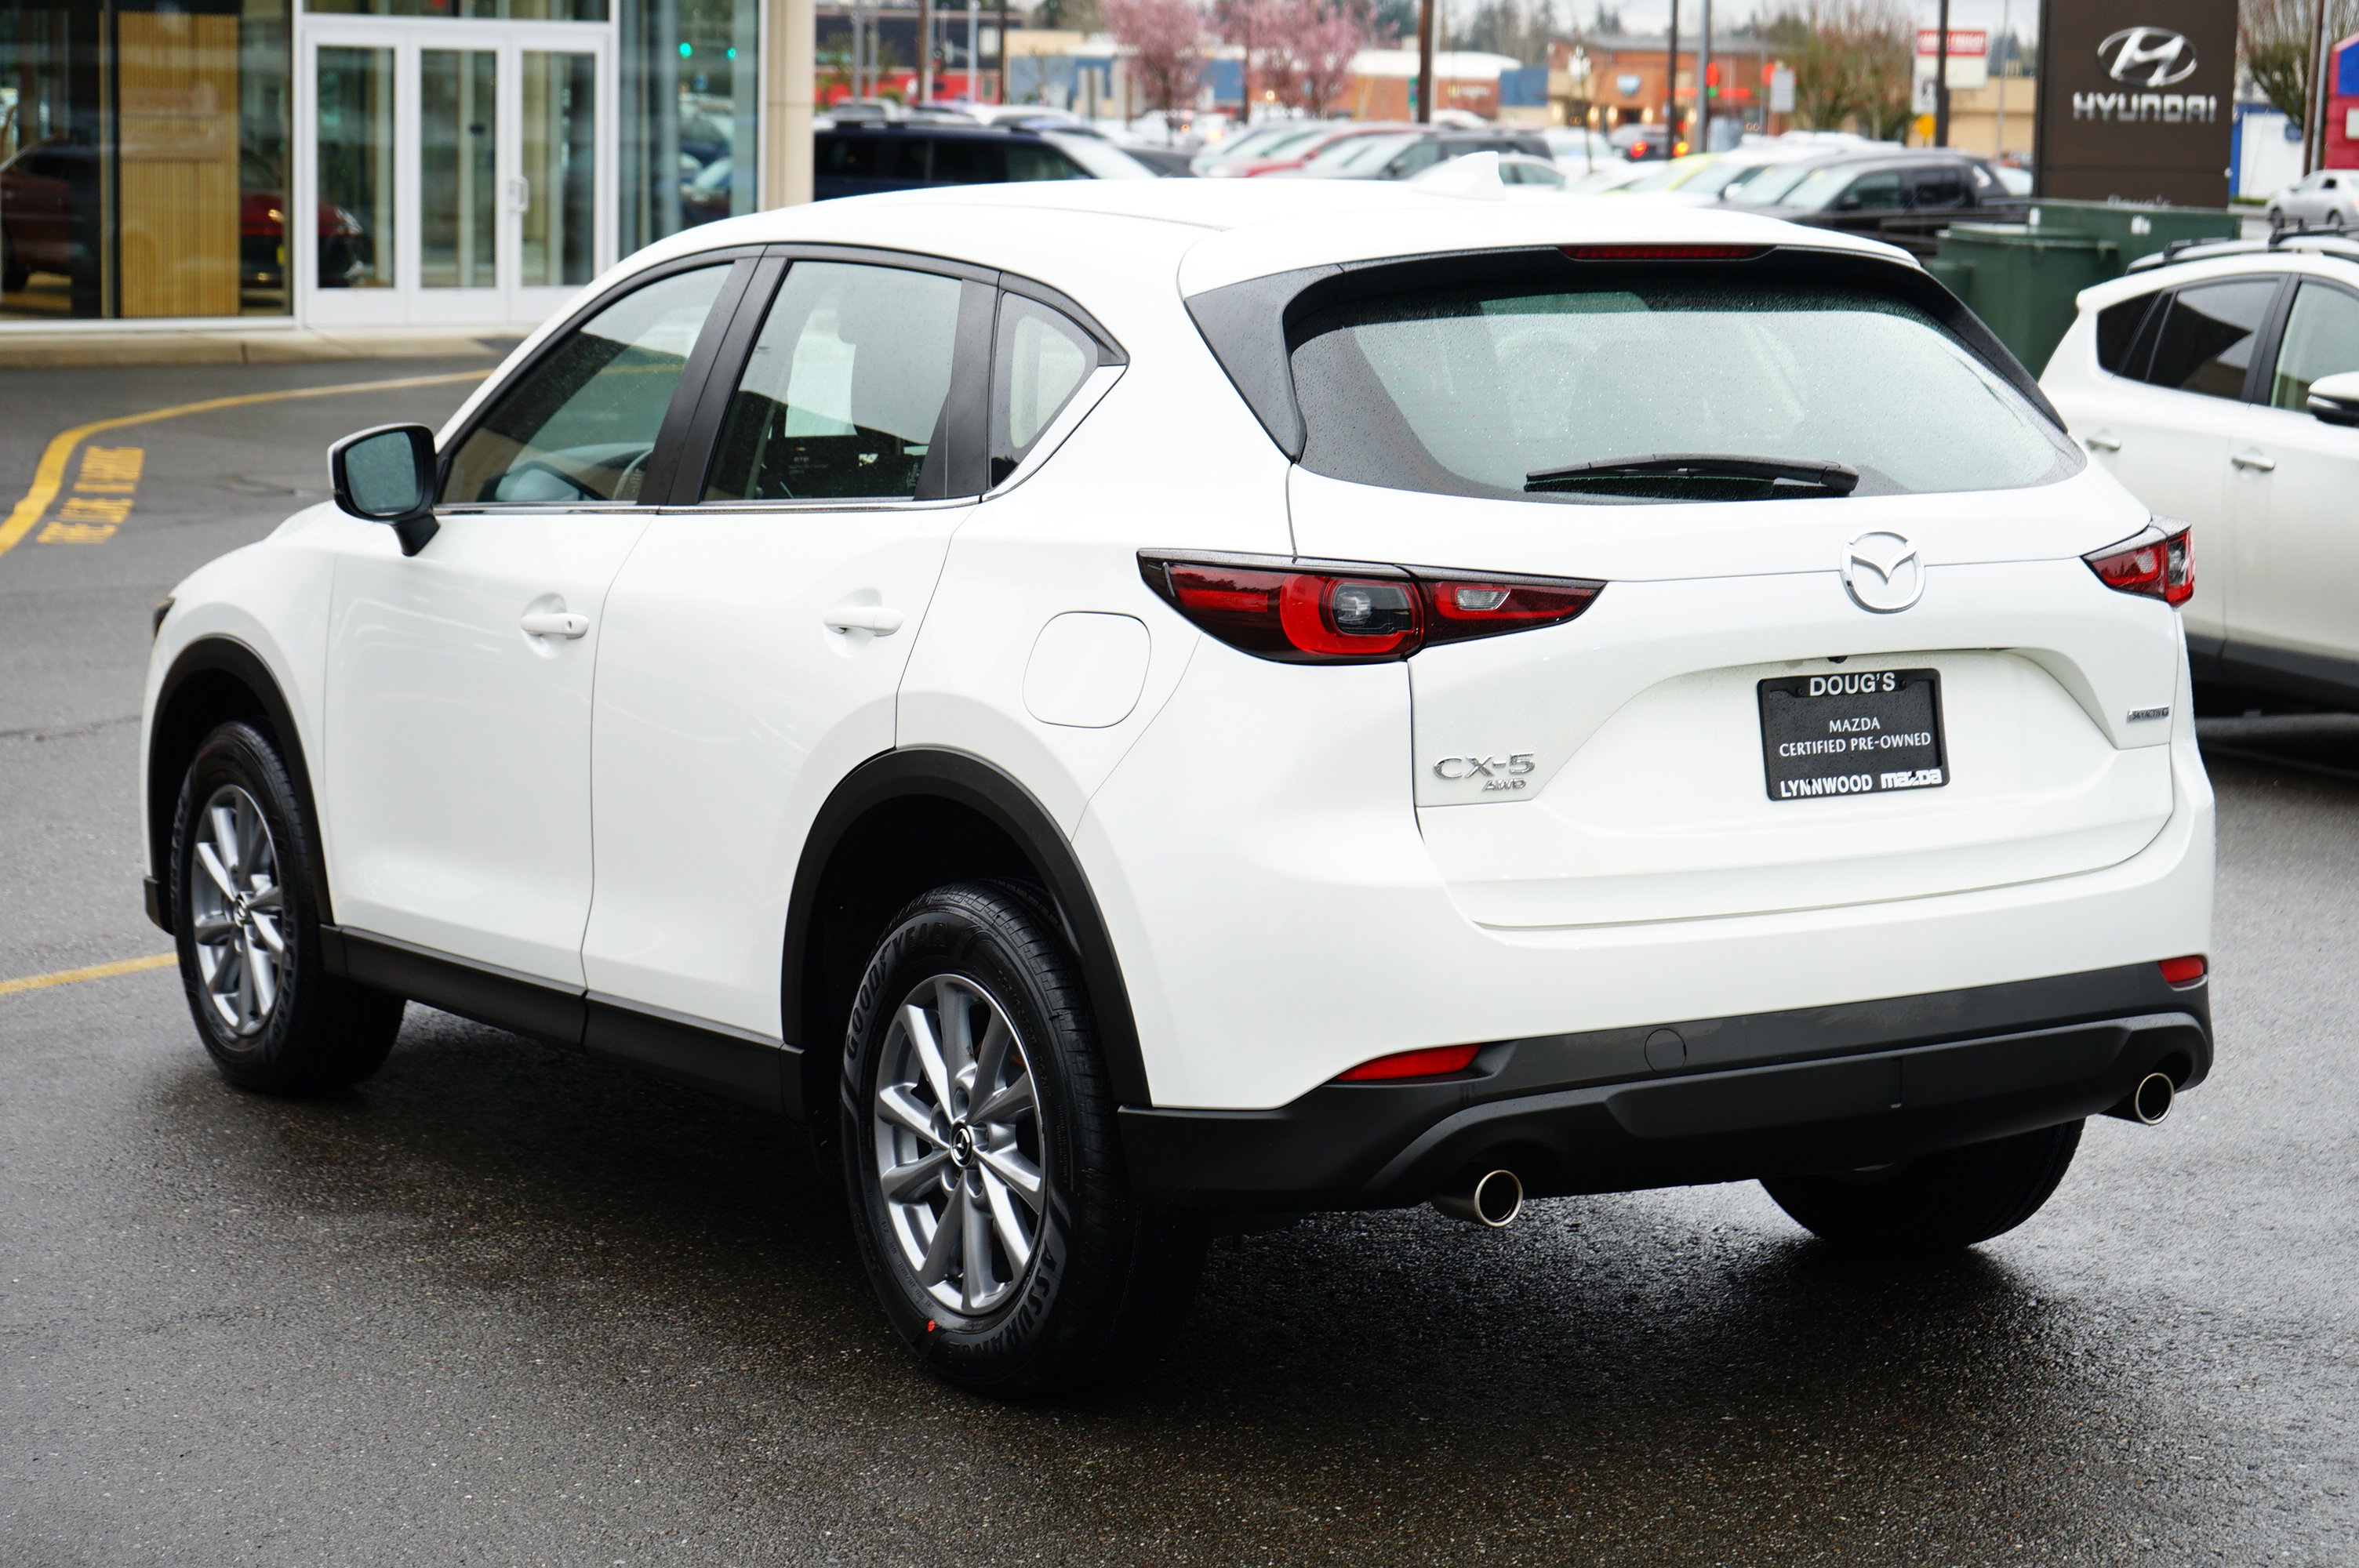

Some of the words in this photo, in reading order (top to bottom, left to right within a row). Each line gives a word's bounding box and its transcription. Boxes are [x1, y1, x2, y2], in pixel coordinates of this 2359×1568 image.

[2073, 92, 2217, 123] HYUNDAI
[1809, 672, 1896, 696] DOUG'S
[1829, 717, 1881, 733] MAZDA
[1779, 739, 1846, 757] CERTIFIED
[1851, 732, 1932, 753] PRE-OWNED
[1433, 752, 1536, 780] CX-5
[1481, 778, 1527, 793] AWD
[1780, 774, 1873, 798] LYNNWOOD
[847, 921, 947, 1060] GOODYEAR
